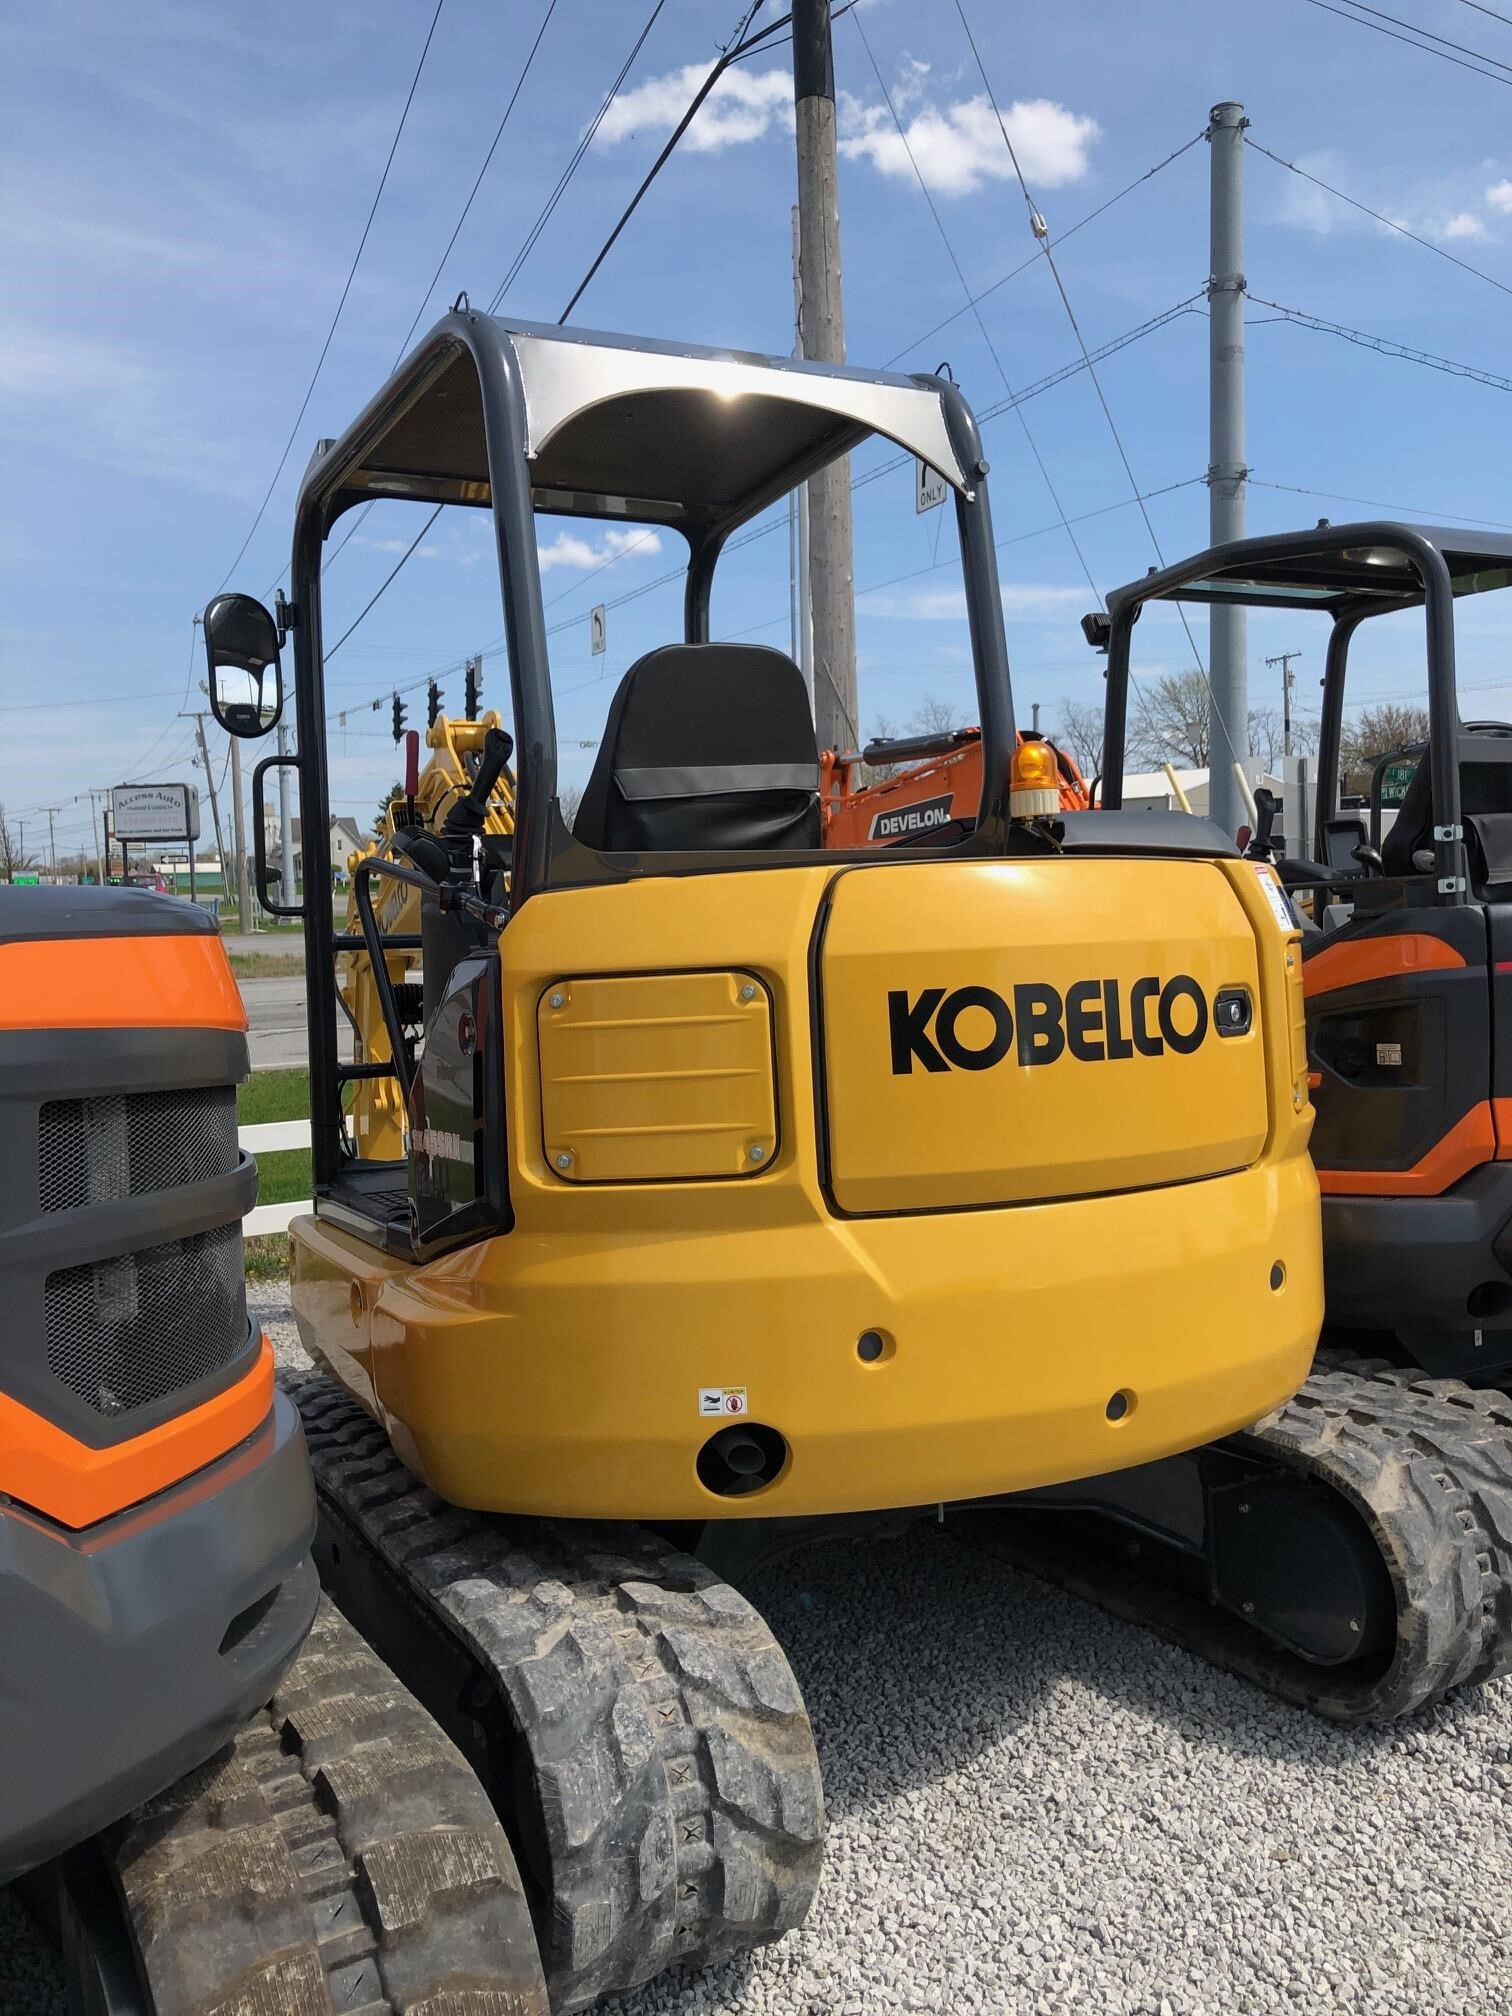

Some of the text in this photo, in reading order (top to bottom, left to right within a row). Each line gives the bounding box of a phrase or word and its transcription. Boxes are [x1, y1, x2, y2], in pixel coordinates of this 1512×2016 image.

[921, 483, 942, 505] ONLY
[880, 808, 944, 835] DEVELON
[888, 974, 1208, 1075] KOBELCO
